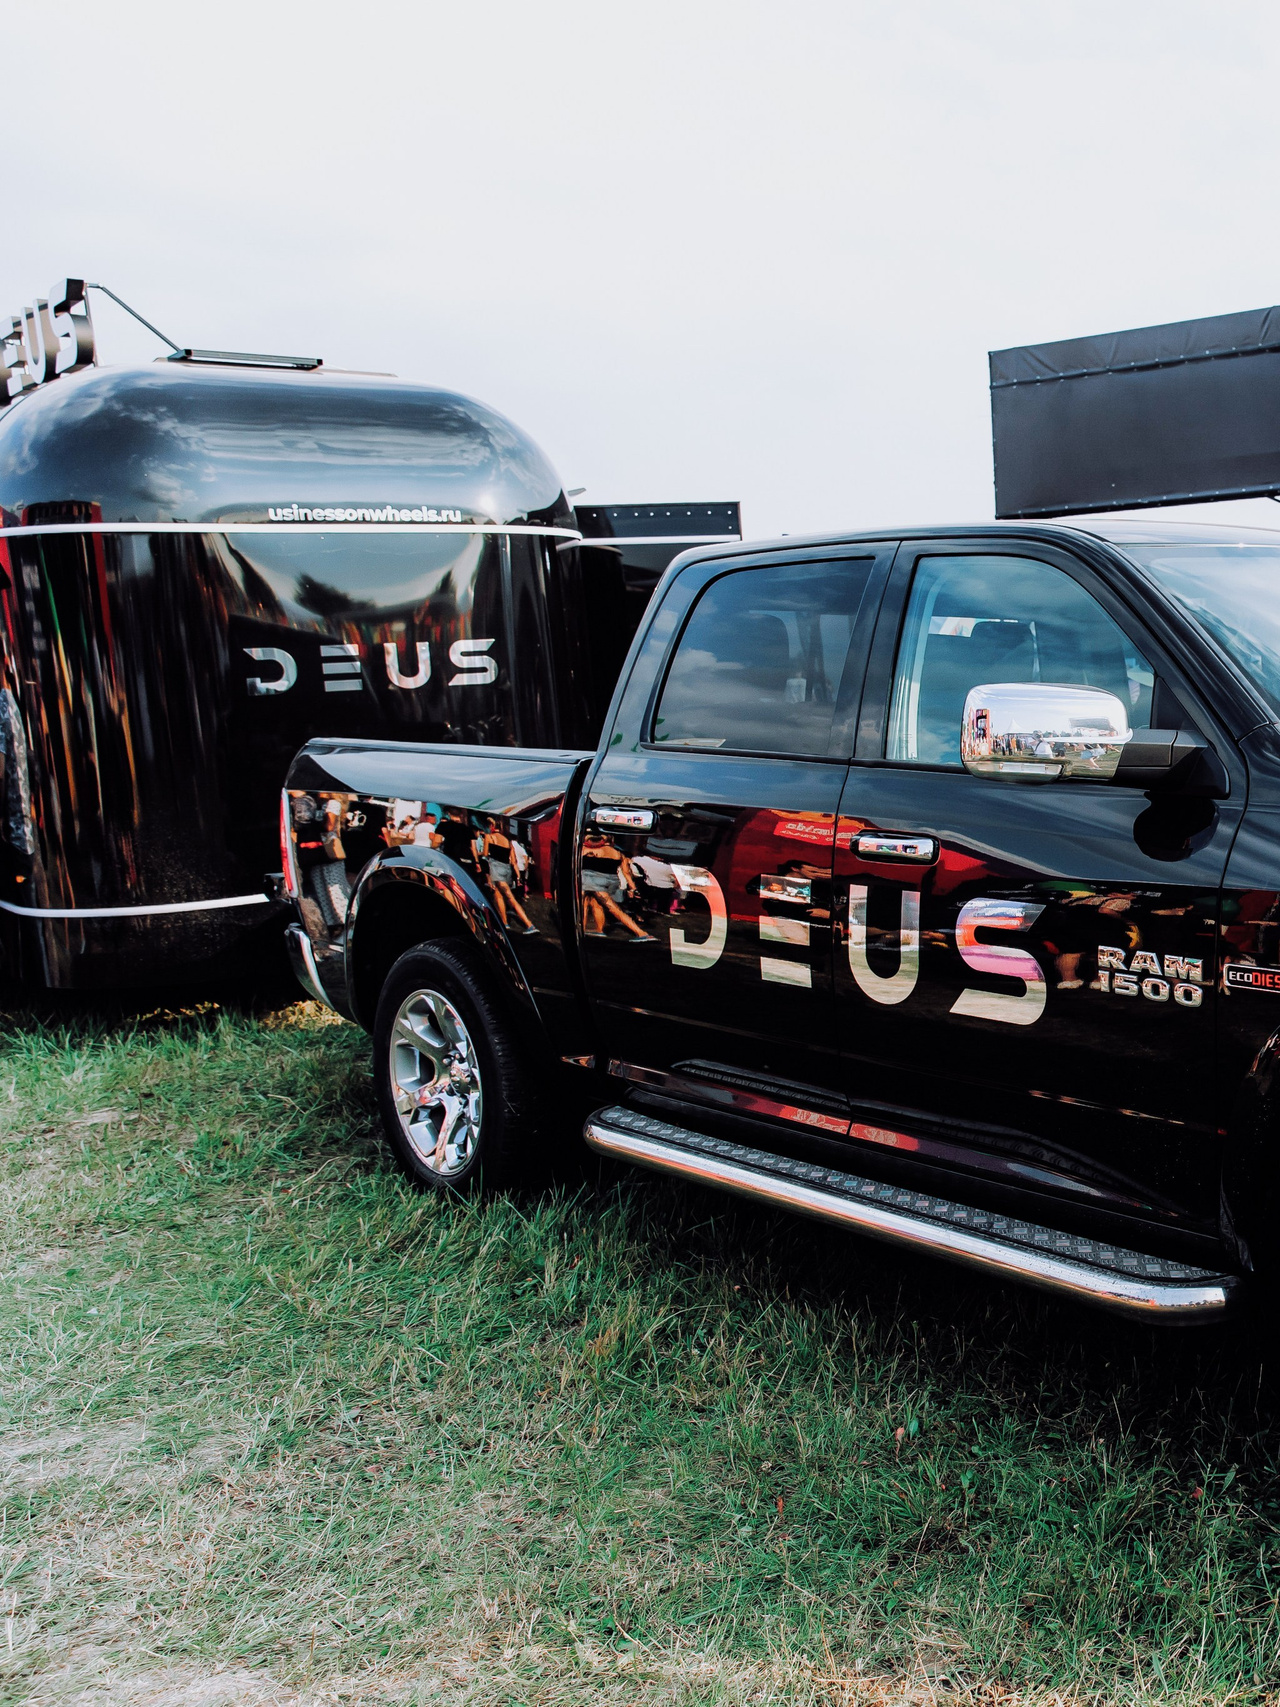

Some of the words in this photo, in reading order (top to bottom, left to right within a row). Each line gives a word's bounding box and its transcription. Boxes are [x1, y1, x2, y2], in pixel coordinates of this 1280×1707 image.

[0, 277, 95, 398] EUS
[268, 504, 462, 523] usinessonwheels.ru
[243, 638, 499, 696] DEUS
[668, 864, 1048, 1026] DEUS
[1098, 945, 1204, 982] RAM
[1098, 970, 1204, 1008] 1500
